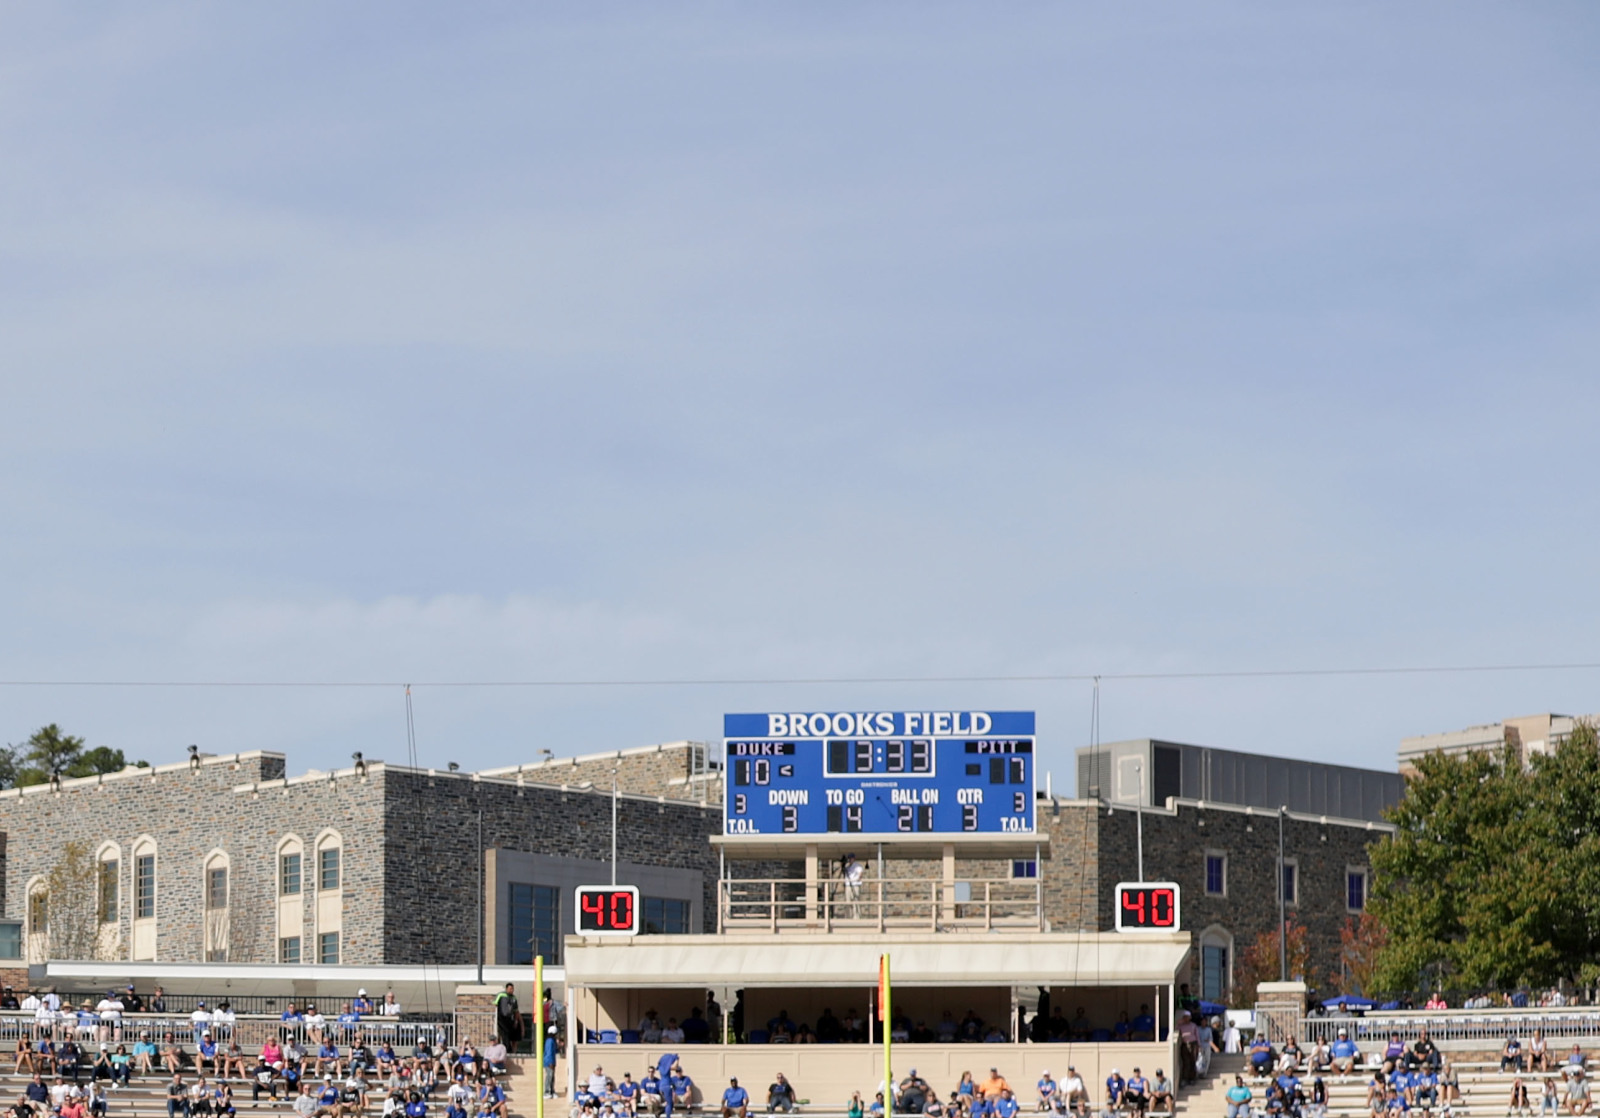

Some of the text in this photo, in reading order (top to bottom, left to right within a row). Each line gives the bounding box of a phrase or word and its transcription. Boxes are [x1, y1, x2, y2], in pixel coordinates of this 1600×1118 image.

[768, 712, 992, 737] BROOKS FIELD
[736, 742, 784, 755] DUKE
[857, 740, 929, 772] 3:33
[977, 740, 1018, 753] PITT
[745, 759, 770, 785] 10
[1011, 757, 1025, 782] 7
[735, 794, 747, 814] 3
[769, 790, 809, 805] DOWN
[825, 789, 865, 805] TO GO
[891, 788, 939, 804] BALL ON
[956, 788, 984, 804] QTR
[1015, 792, 1025, 812] 3
[728, 819, 760, 834] T.O.L.
[784, 806, 798, 832] 3
[847, 807, 862, 830] 4
[898, 805, 933, 831] 21
[964, 805, 978, 831] 3
[1000, 817, 1033, 832] T.O.L.
[582, 892, 632, 929] 40
[1123, 888, 1174, 926] 40
